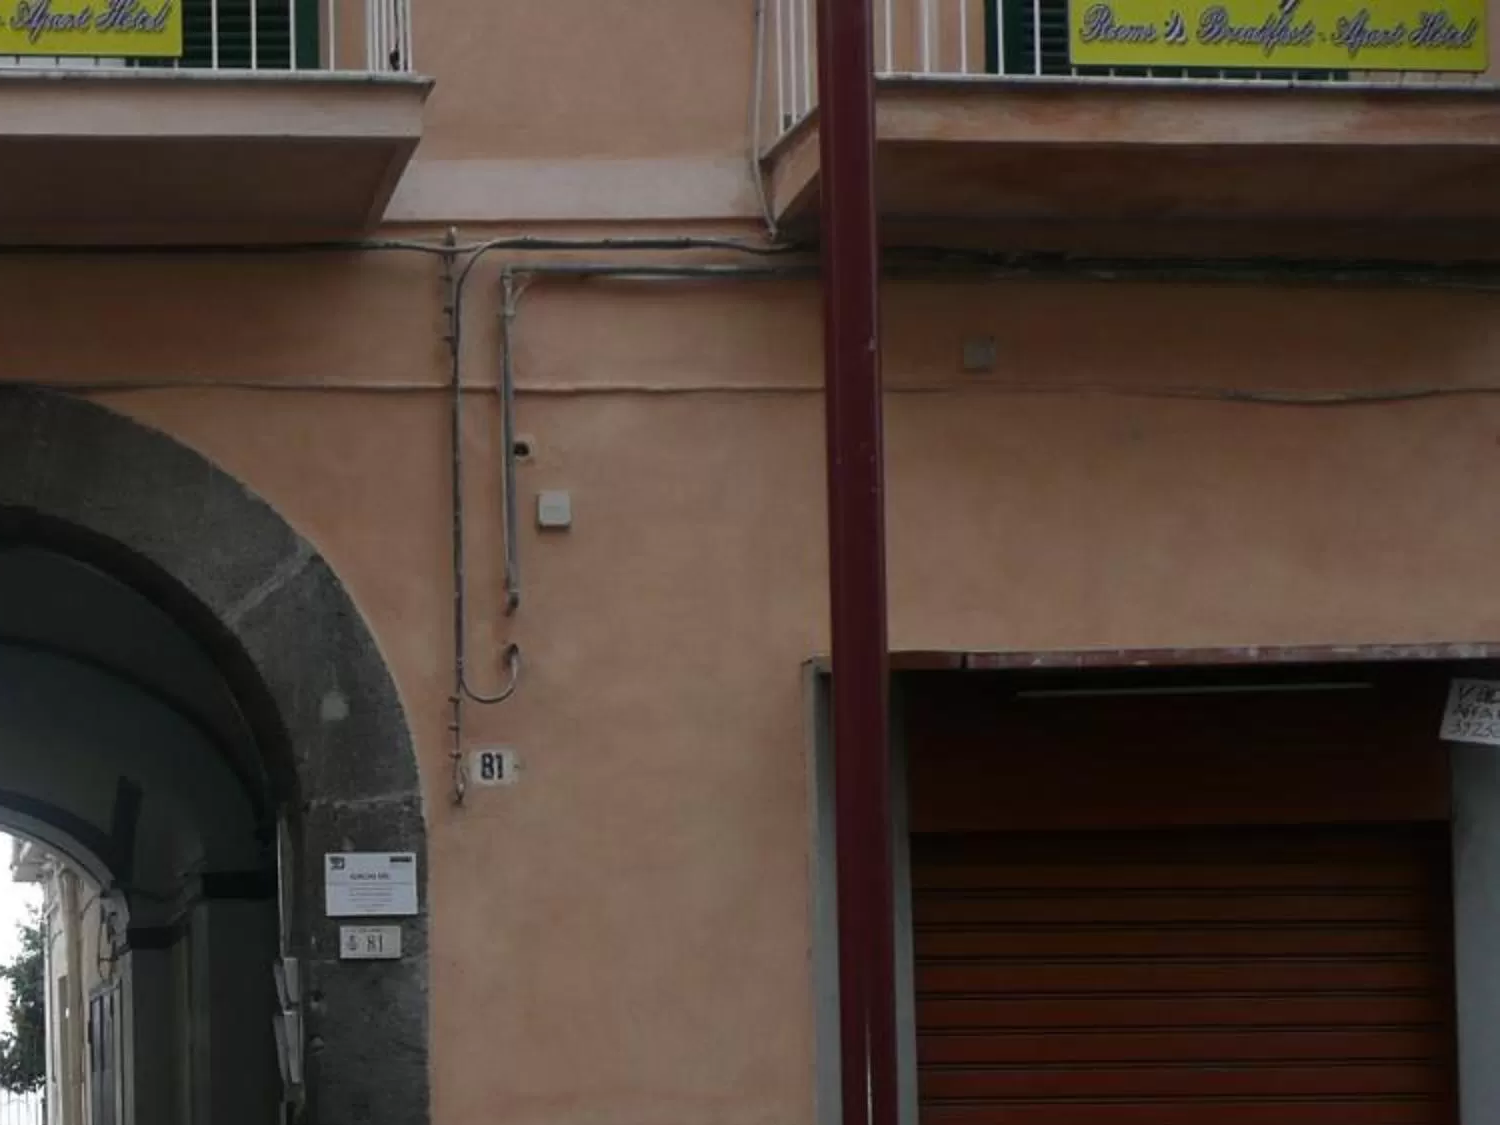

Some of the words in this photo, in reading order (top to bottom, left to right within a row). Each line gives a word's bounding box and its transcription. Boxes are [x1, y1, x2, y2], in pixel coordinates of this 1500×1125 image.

[1079, 3, 1158, 43] Rooms
[1196, 5, 1315, 58] Breakfast
[1331, 8, 1406, 60] Apart
[1408, 10, 1479, 49] Hotel
[481, 752, 504, 780] 81
